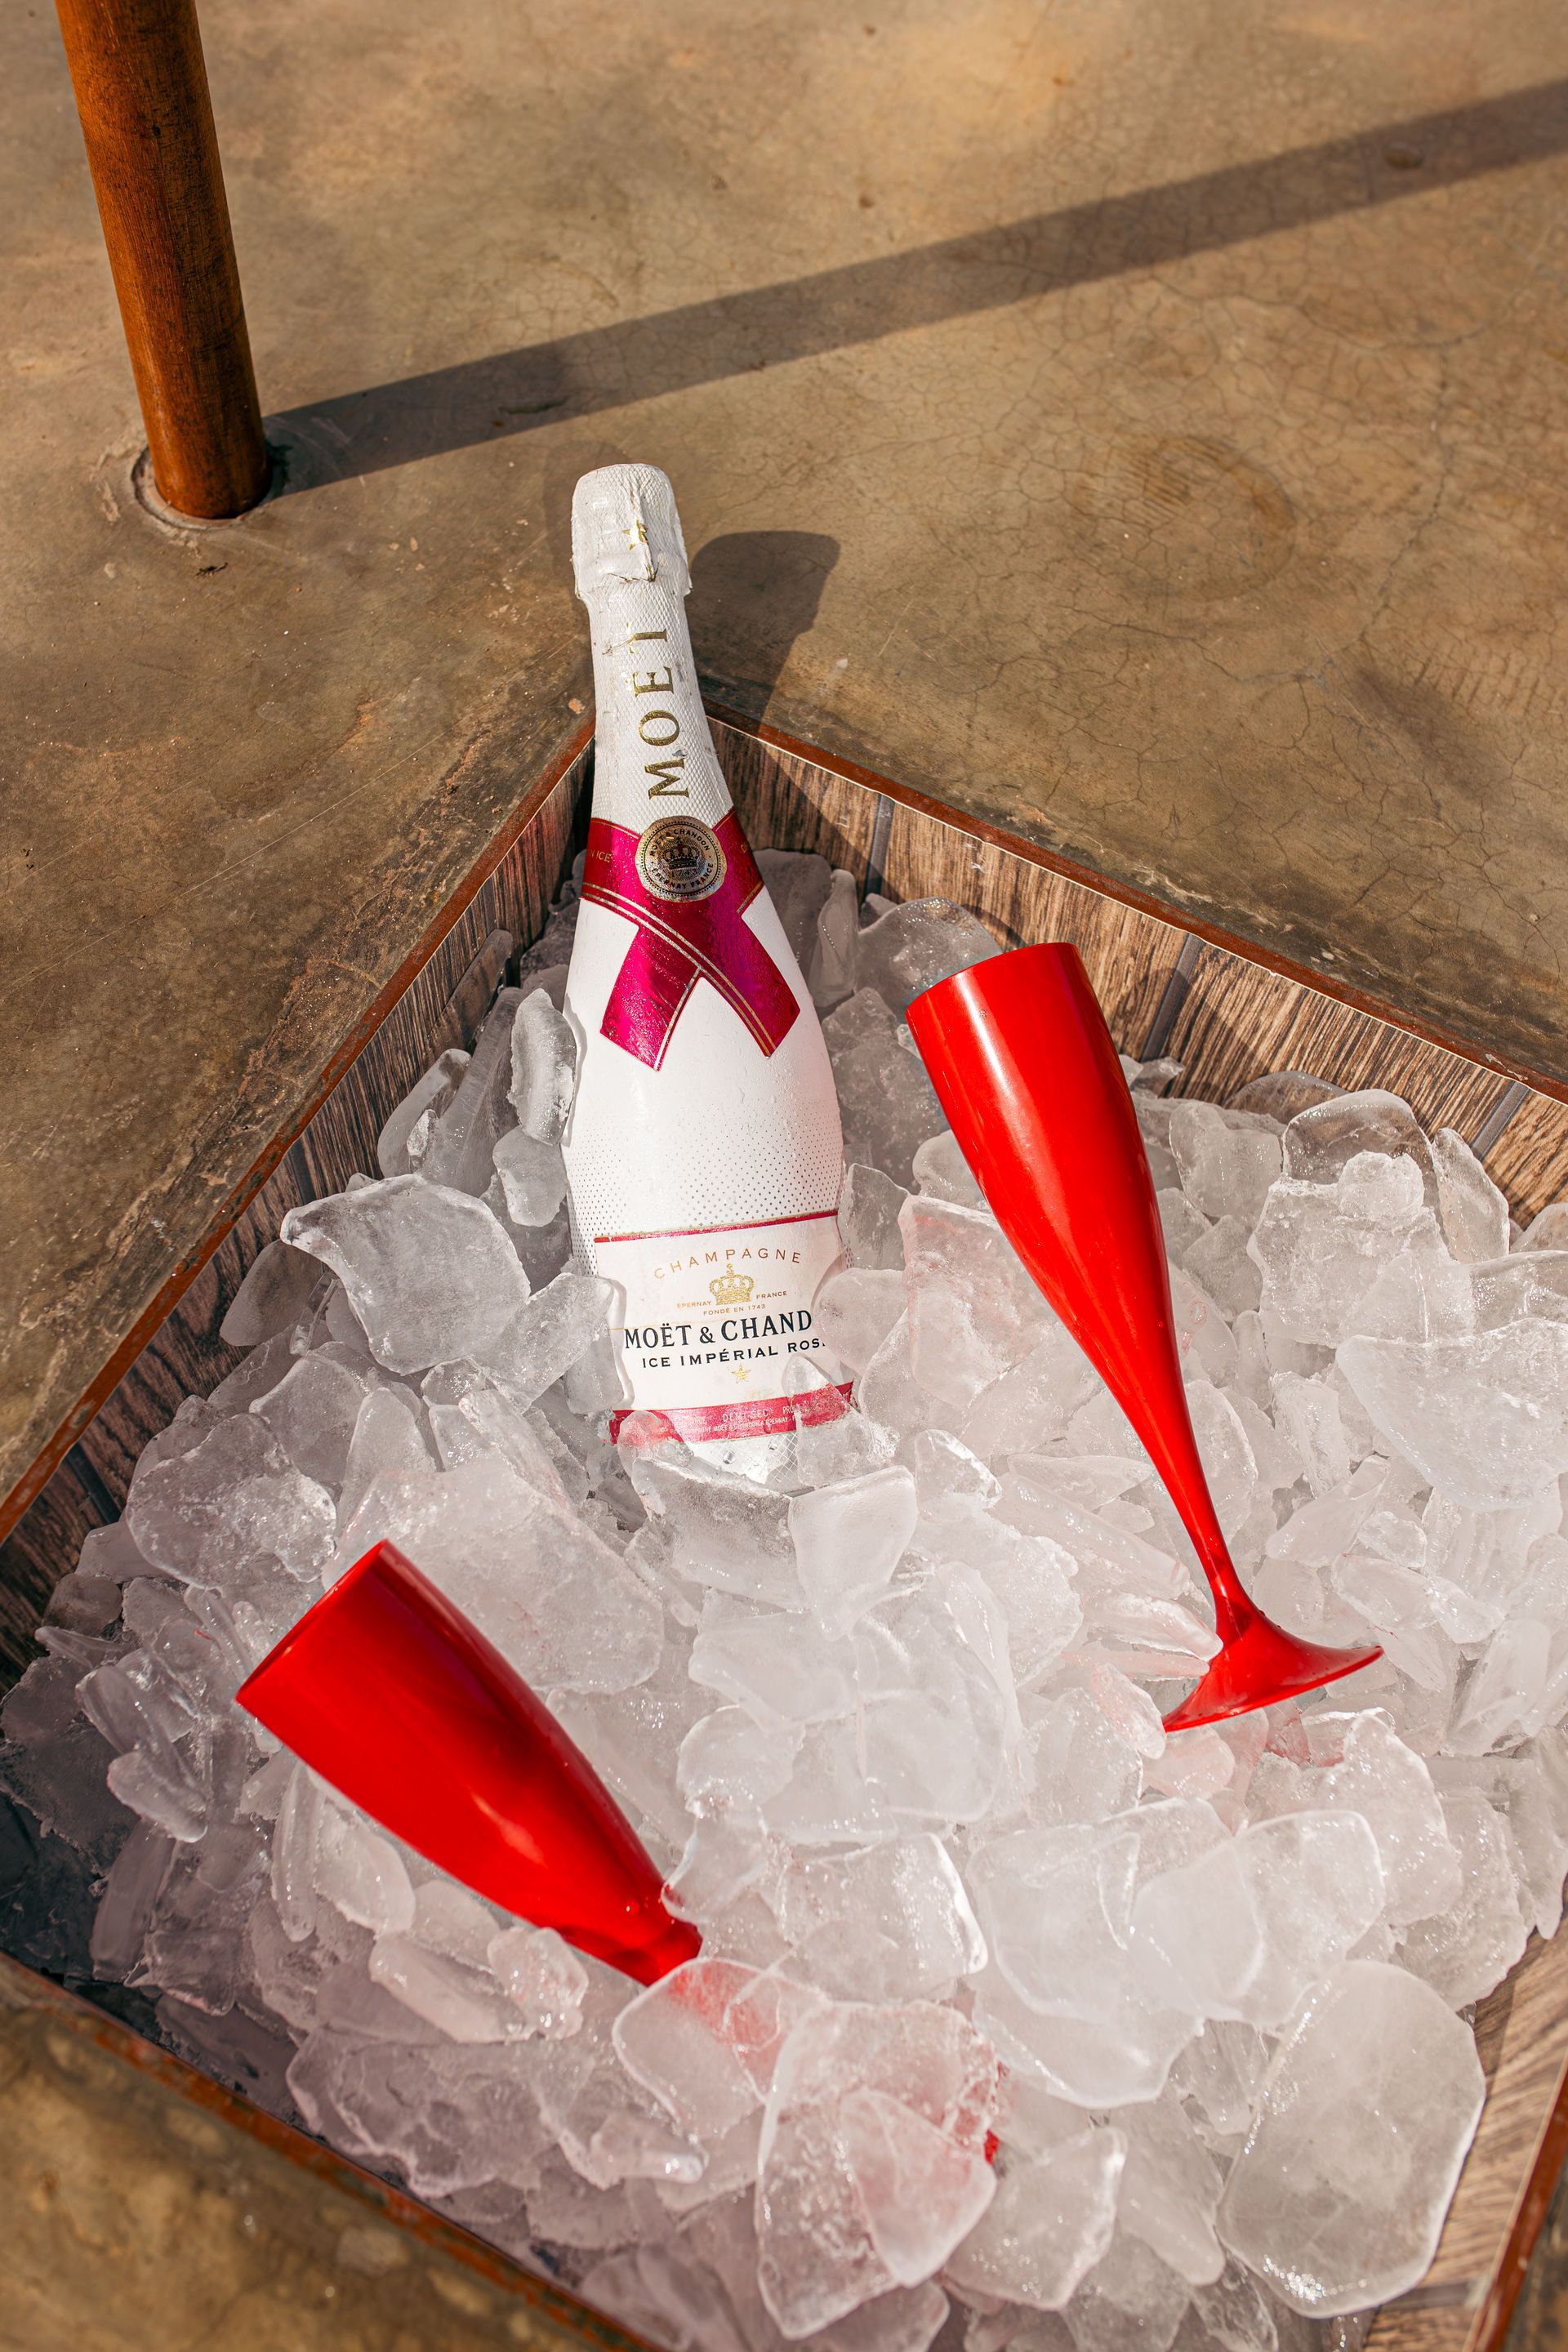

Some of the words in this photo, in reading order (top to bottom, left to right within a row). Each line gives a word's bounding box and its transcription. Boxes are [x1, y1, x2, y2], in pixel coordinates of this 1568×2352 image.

[673, 828, 710, 851] CHANDON
[690, 862, 714, 888] FRANCE
[653, 1247, 801, 1280] CHAMPAGNE
[755, 1290, 787, 1300] FRANCE
[624, 1323, 692, 1349] MOËT
[699, 1326, 716, 1344] &
[720, 1309, 813, 1342] CHAND
[643, 1357, 670, 1369] ICE
[680, 1345, 778, 1366] IMPÉRIAL
[787, 1338, 826, 1353] ROS
